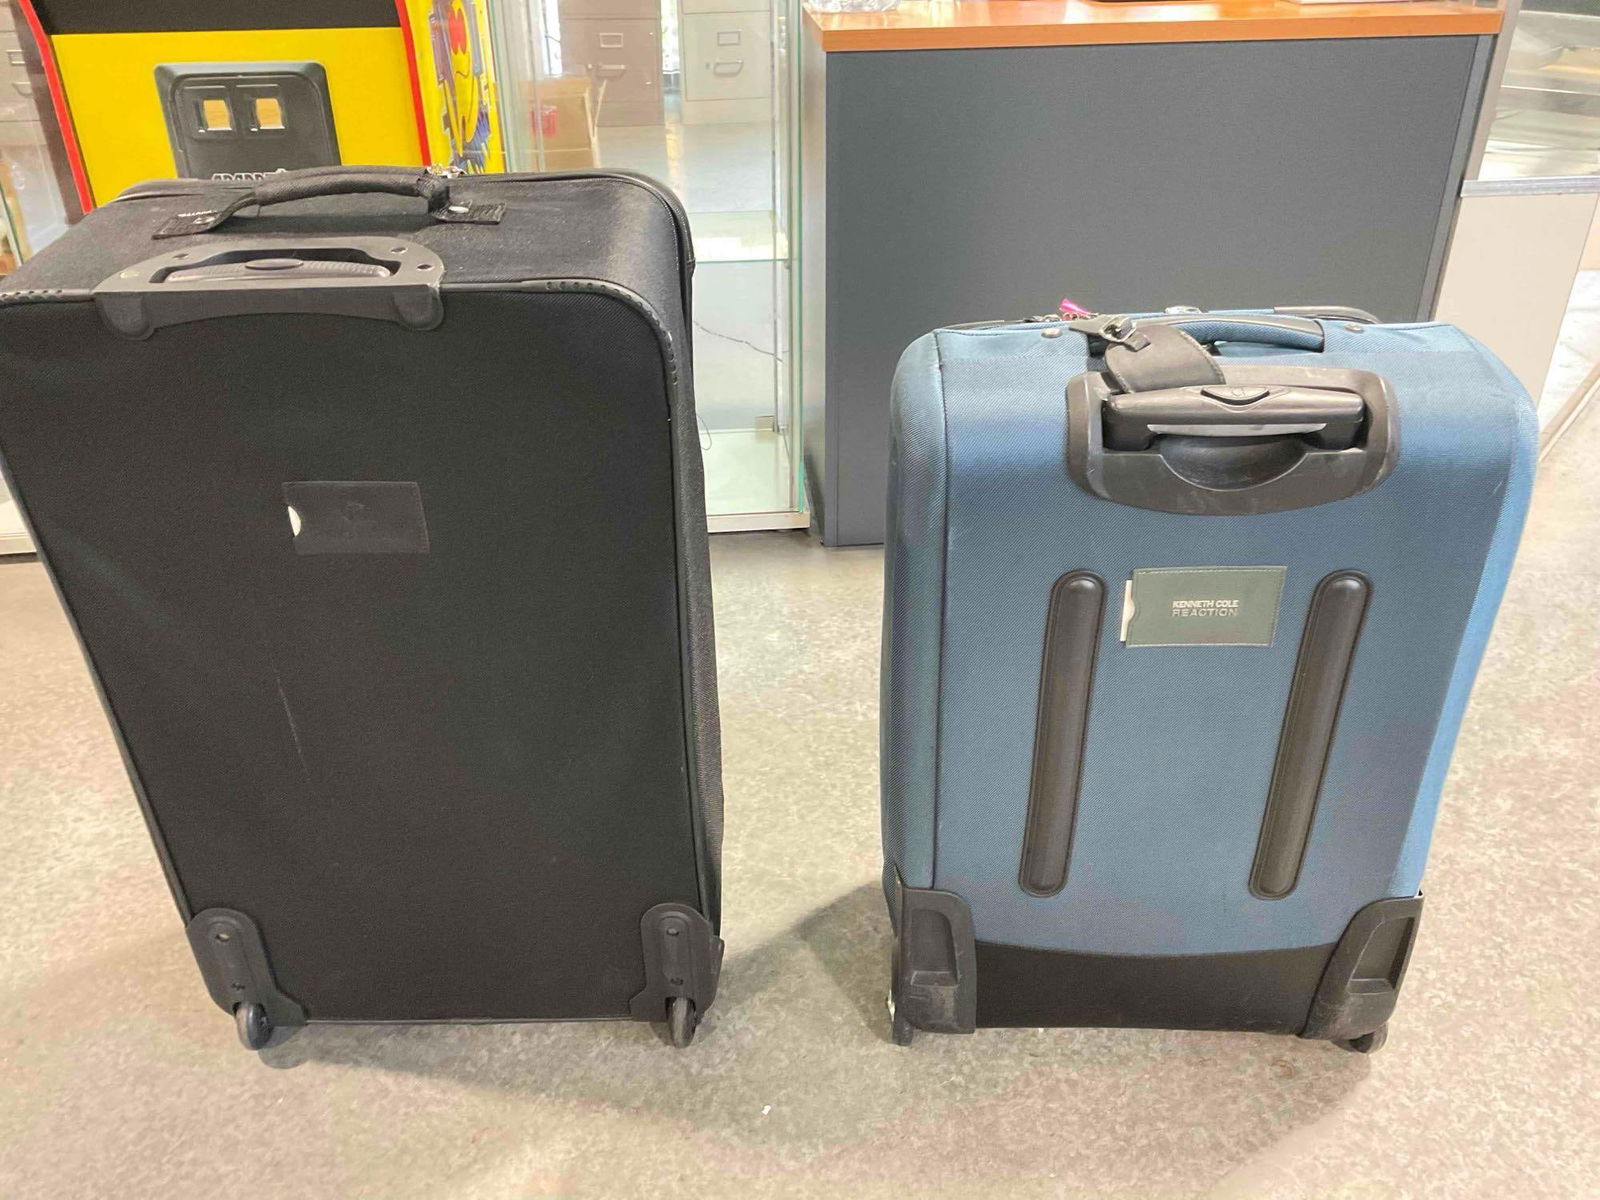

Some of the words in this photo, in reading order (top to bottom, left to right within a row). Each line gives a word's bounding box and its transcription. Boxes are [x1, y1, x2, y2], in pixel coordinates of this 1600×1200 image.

[1172, 600, 1214, 608] KENNETH
[1215, 599, 1239, 608] COLE
[1172, 608, 1238, 617] REACTION
